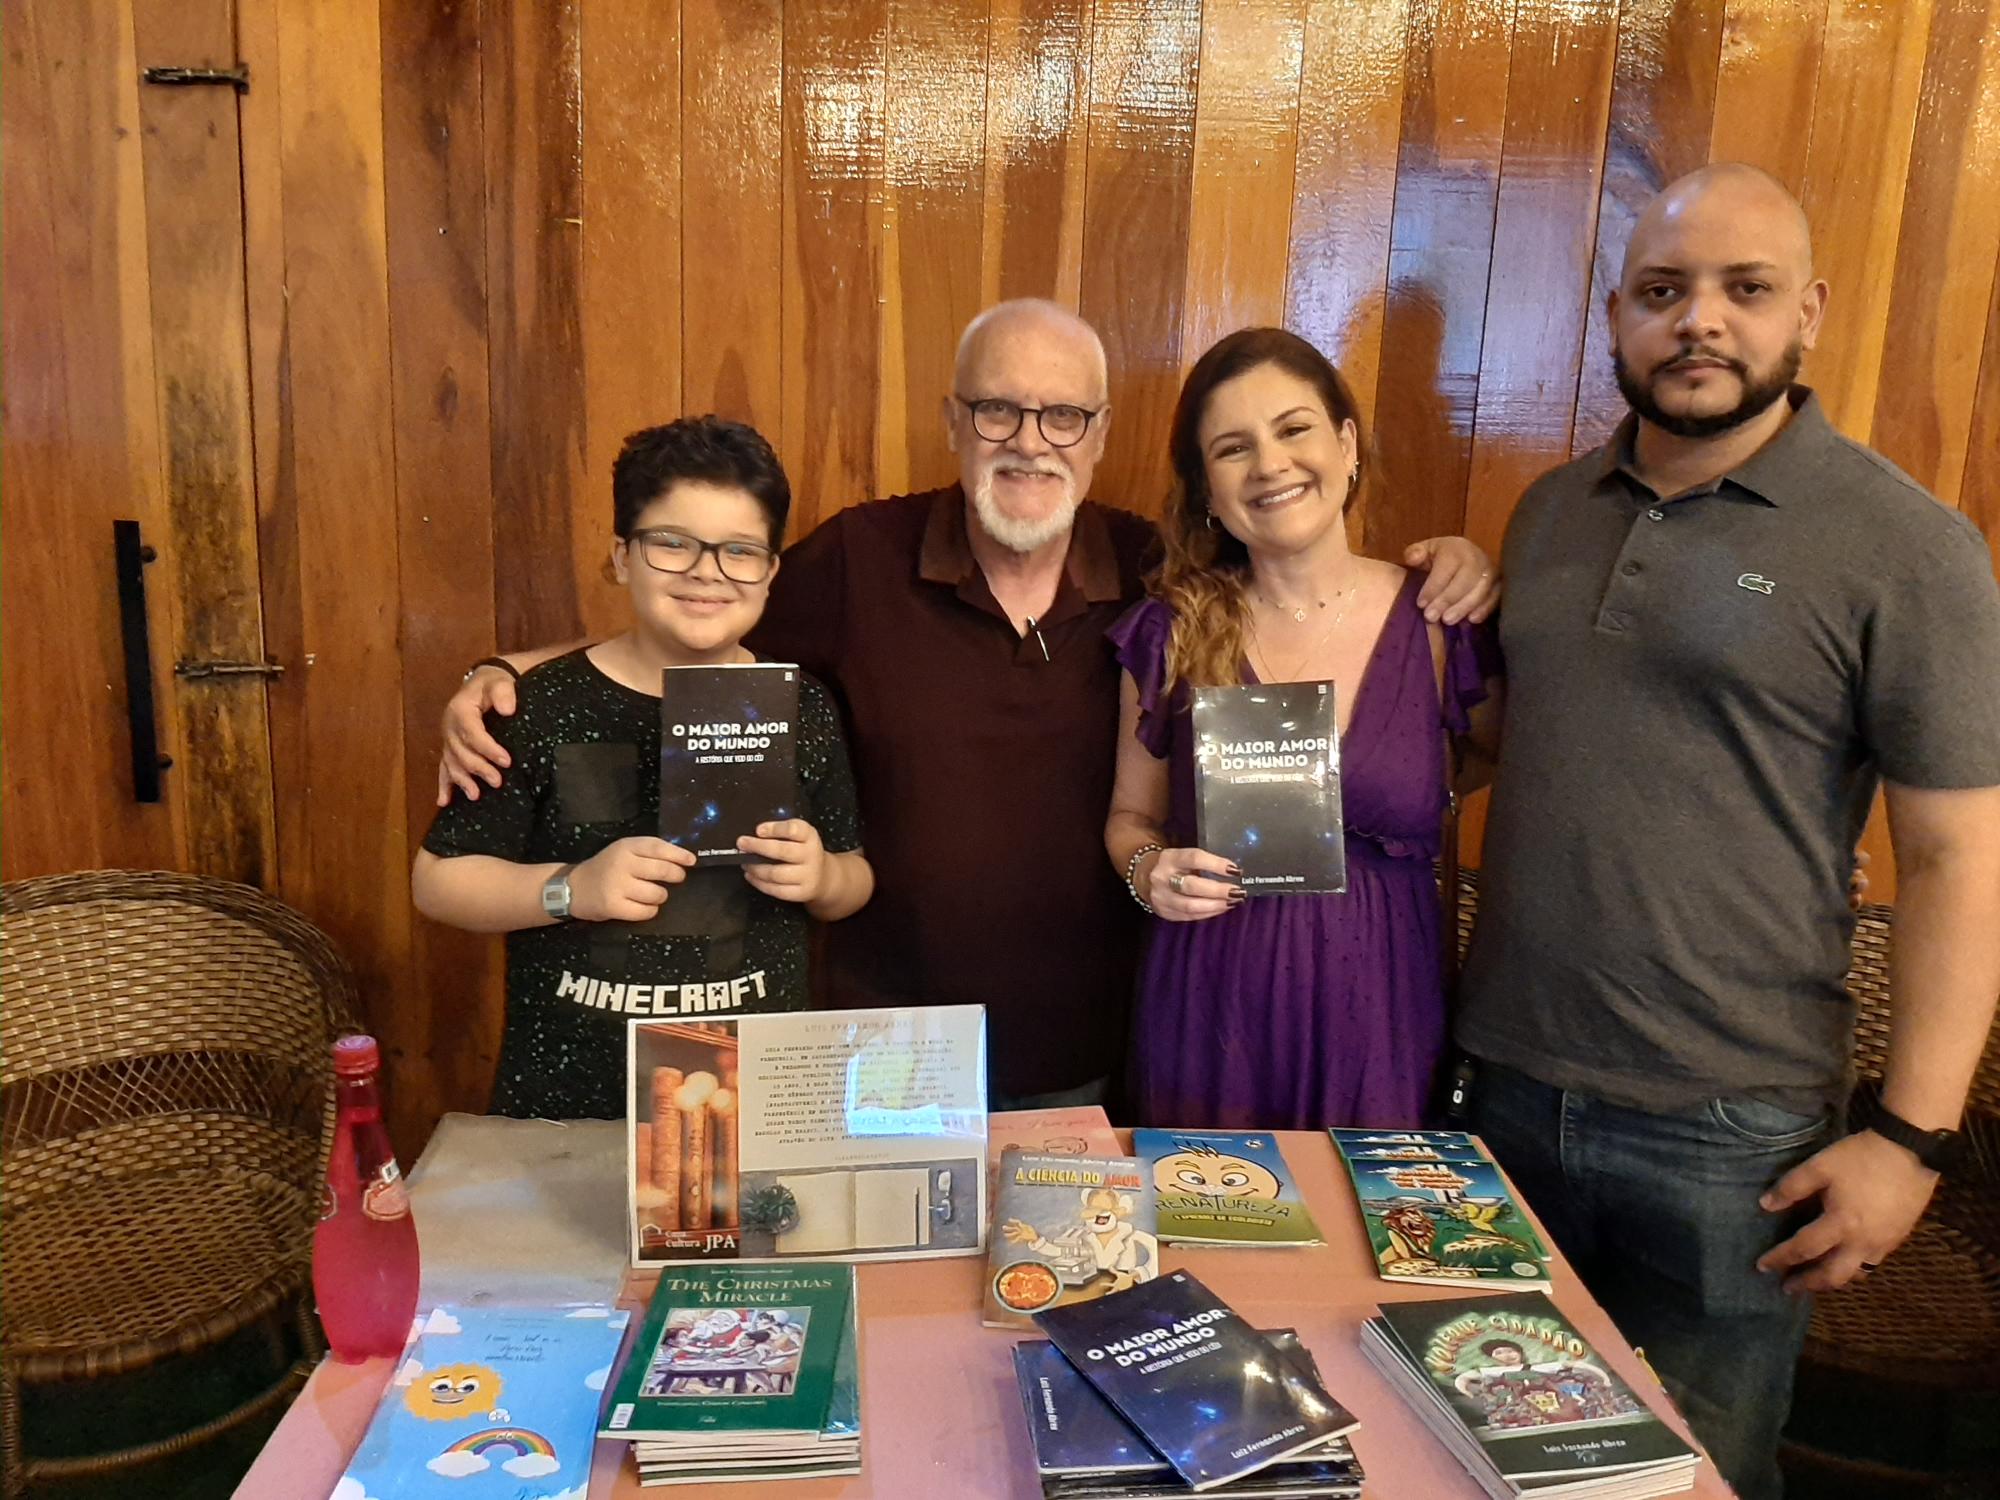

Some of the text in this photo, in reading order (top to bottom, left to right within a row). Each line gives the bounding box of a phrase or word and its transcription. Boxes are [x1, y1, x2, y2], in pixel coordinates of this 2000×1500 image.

[672, 722, 789, 736] O MAIOR AMOR
[688, 737, 771, 750] DO MUNDO
[1221, 740, 1275, 754] MAIOR
[1279, 738, 1328, 752] AMOR
[1221, 755, 1308, 770] DO MUNDO
[556, 970, 767, 1014] MINECRAFT
[1015, 1167, 1025, 1181] A
[1082, 1170, 1100, 1184] DO
[1104, 1173, 1143, 1187] AMOR
[665, 1238, 701, 1248] Cultura
[702, 1234, 736, 1253] JPA
[667, 1278, 833, 1291] THE CHRISTMAS
[699, 1291, 793, 1303] MIRACLE
[1086, 1308, 1227, 1360] O MAIOR AMOR
[1114, 1327, 1217, 1367] DO MUNDO
[1424, 1314, 1586, 1374] MOLEQUE CIDADÃO
[1246, 1433, 1285, 1453] Fernando
